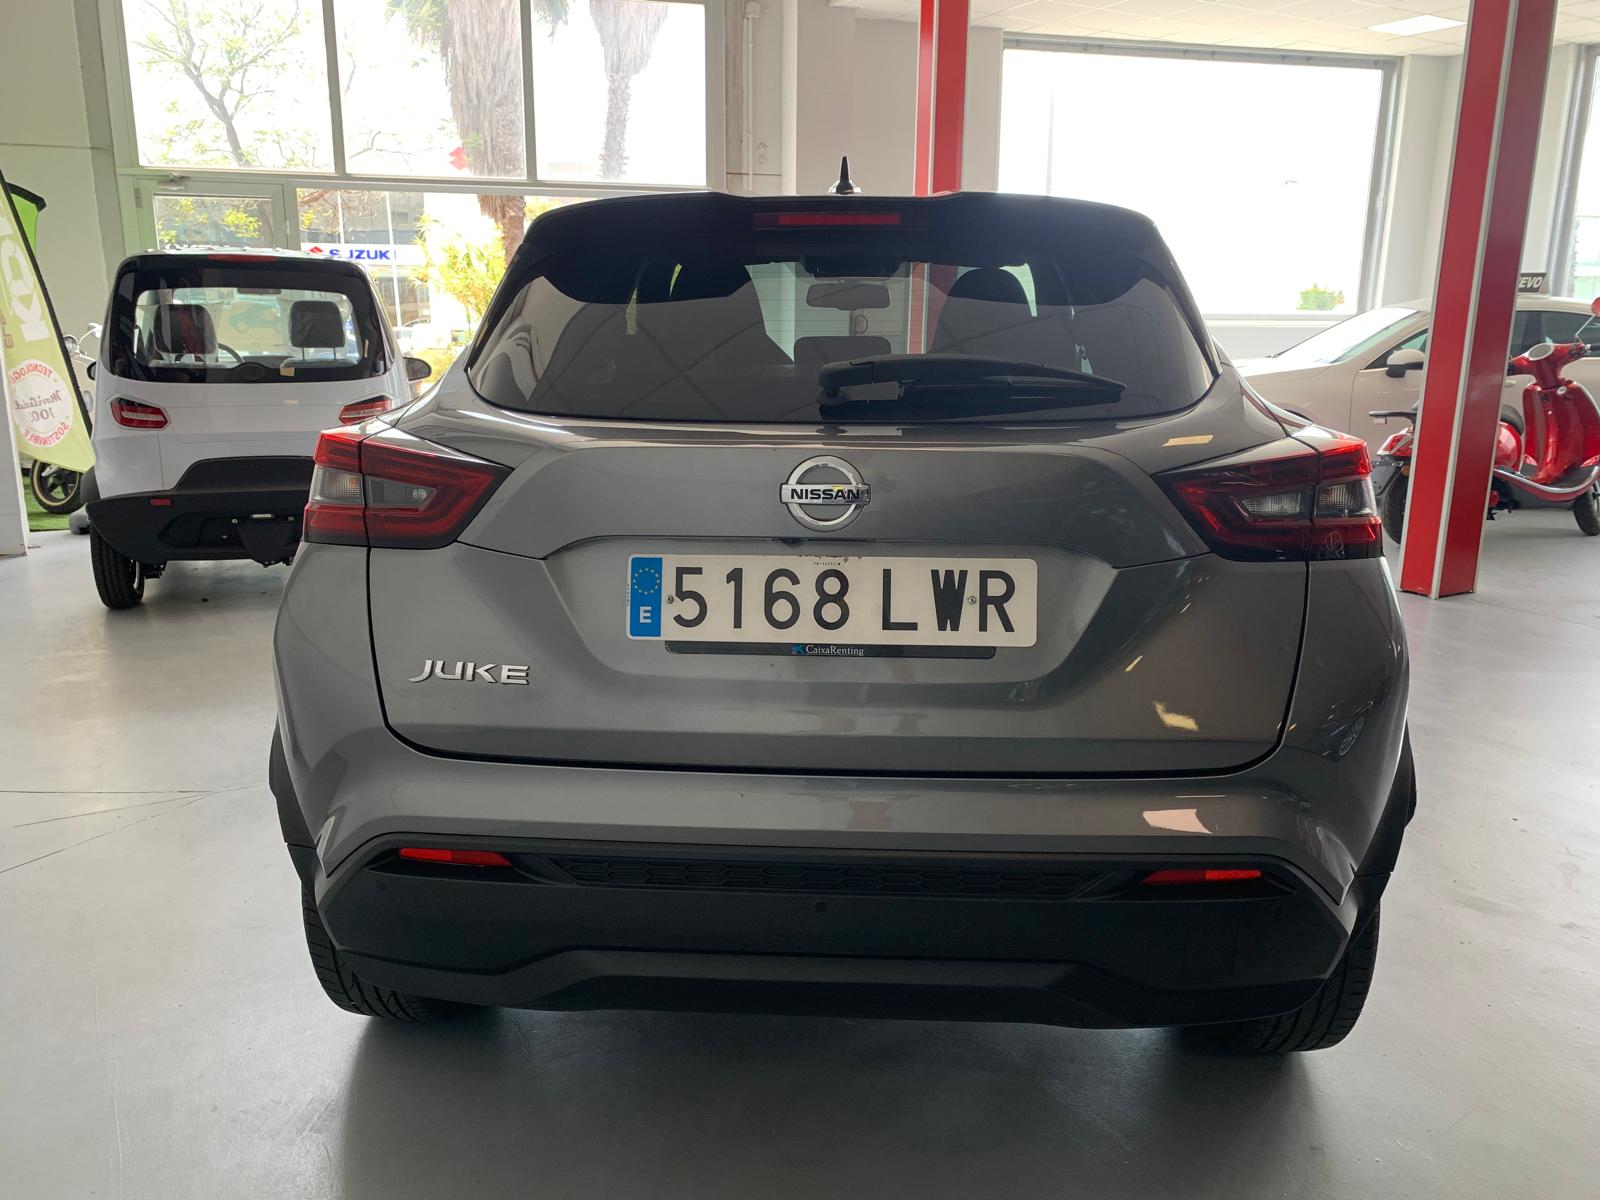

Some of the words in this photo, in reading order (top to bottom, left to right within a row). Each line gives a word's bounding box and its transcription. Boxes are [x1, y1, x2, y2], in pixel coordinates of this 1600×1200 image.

[1519, 277, 1543, 288] EVO
[791, 489, 860, 500] NISSAN
[673, 567, 850, 630] 5168
[882, 569, 1016, 633] LWR
[640, 606, 652, 623] E
[805, 644, 865, 656] CaixaRenting
[408, 659, 530, 685] JUKE
